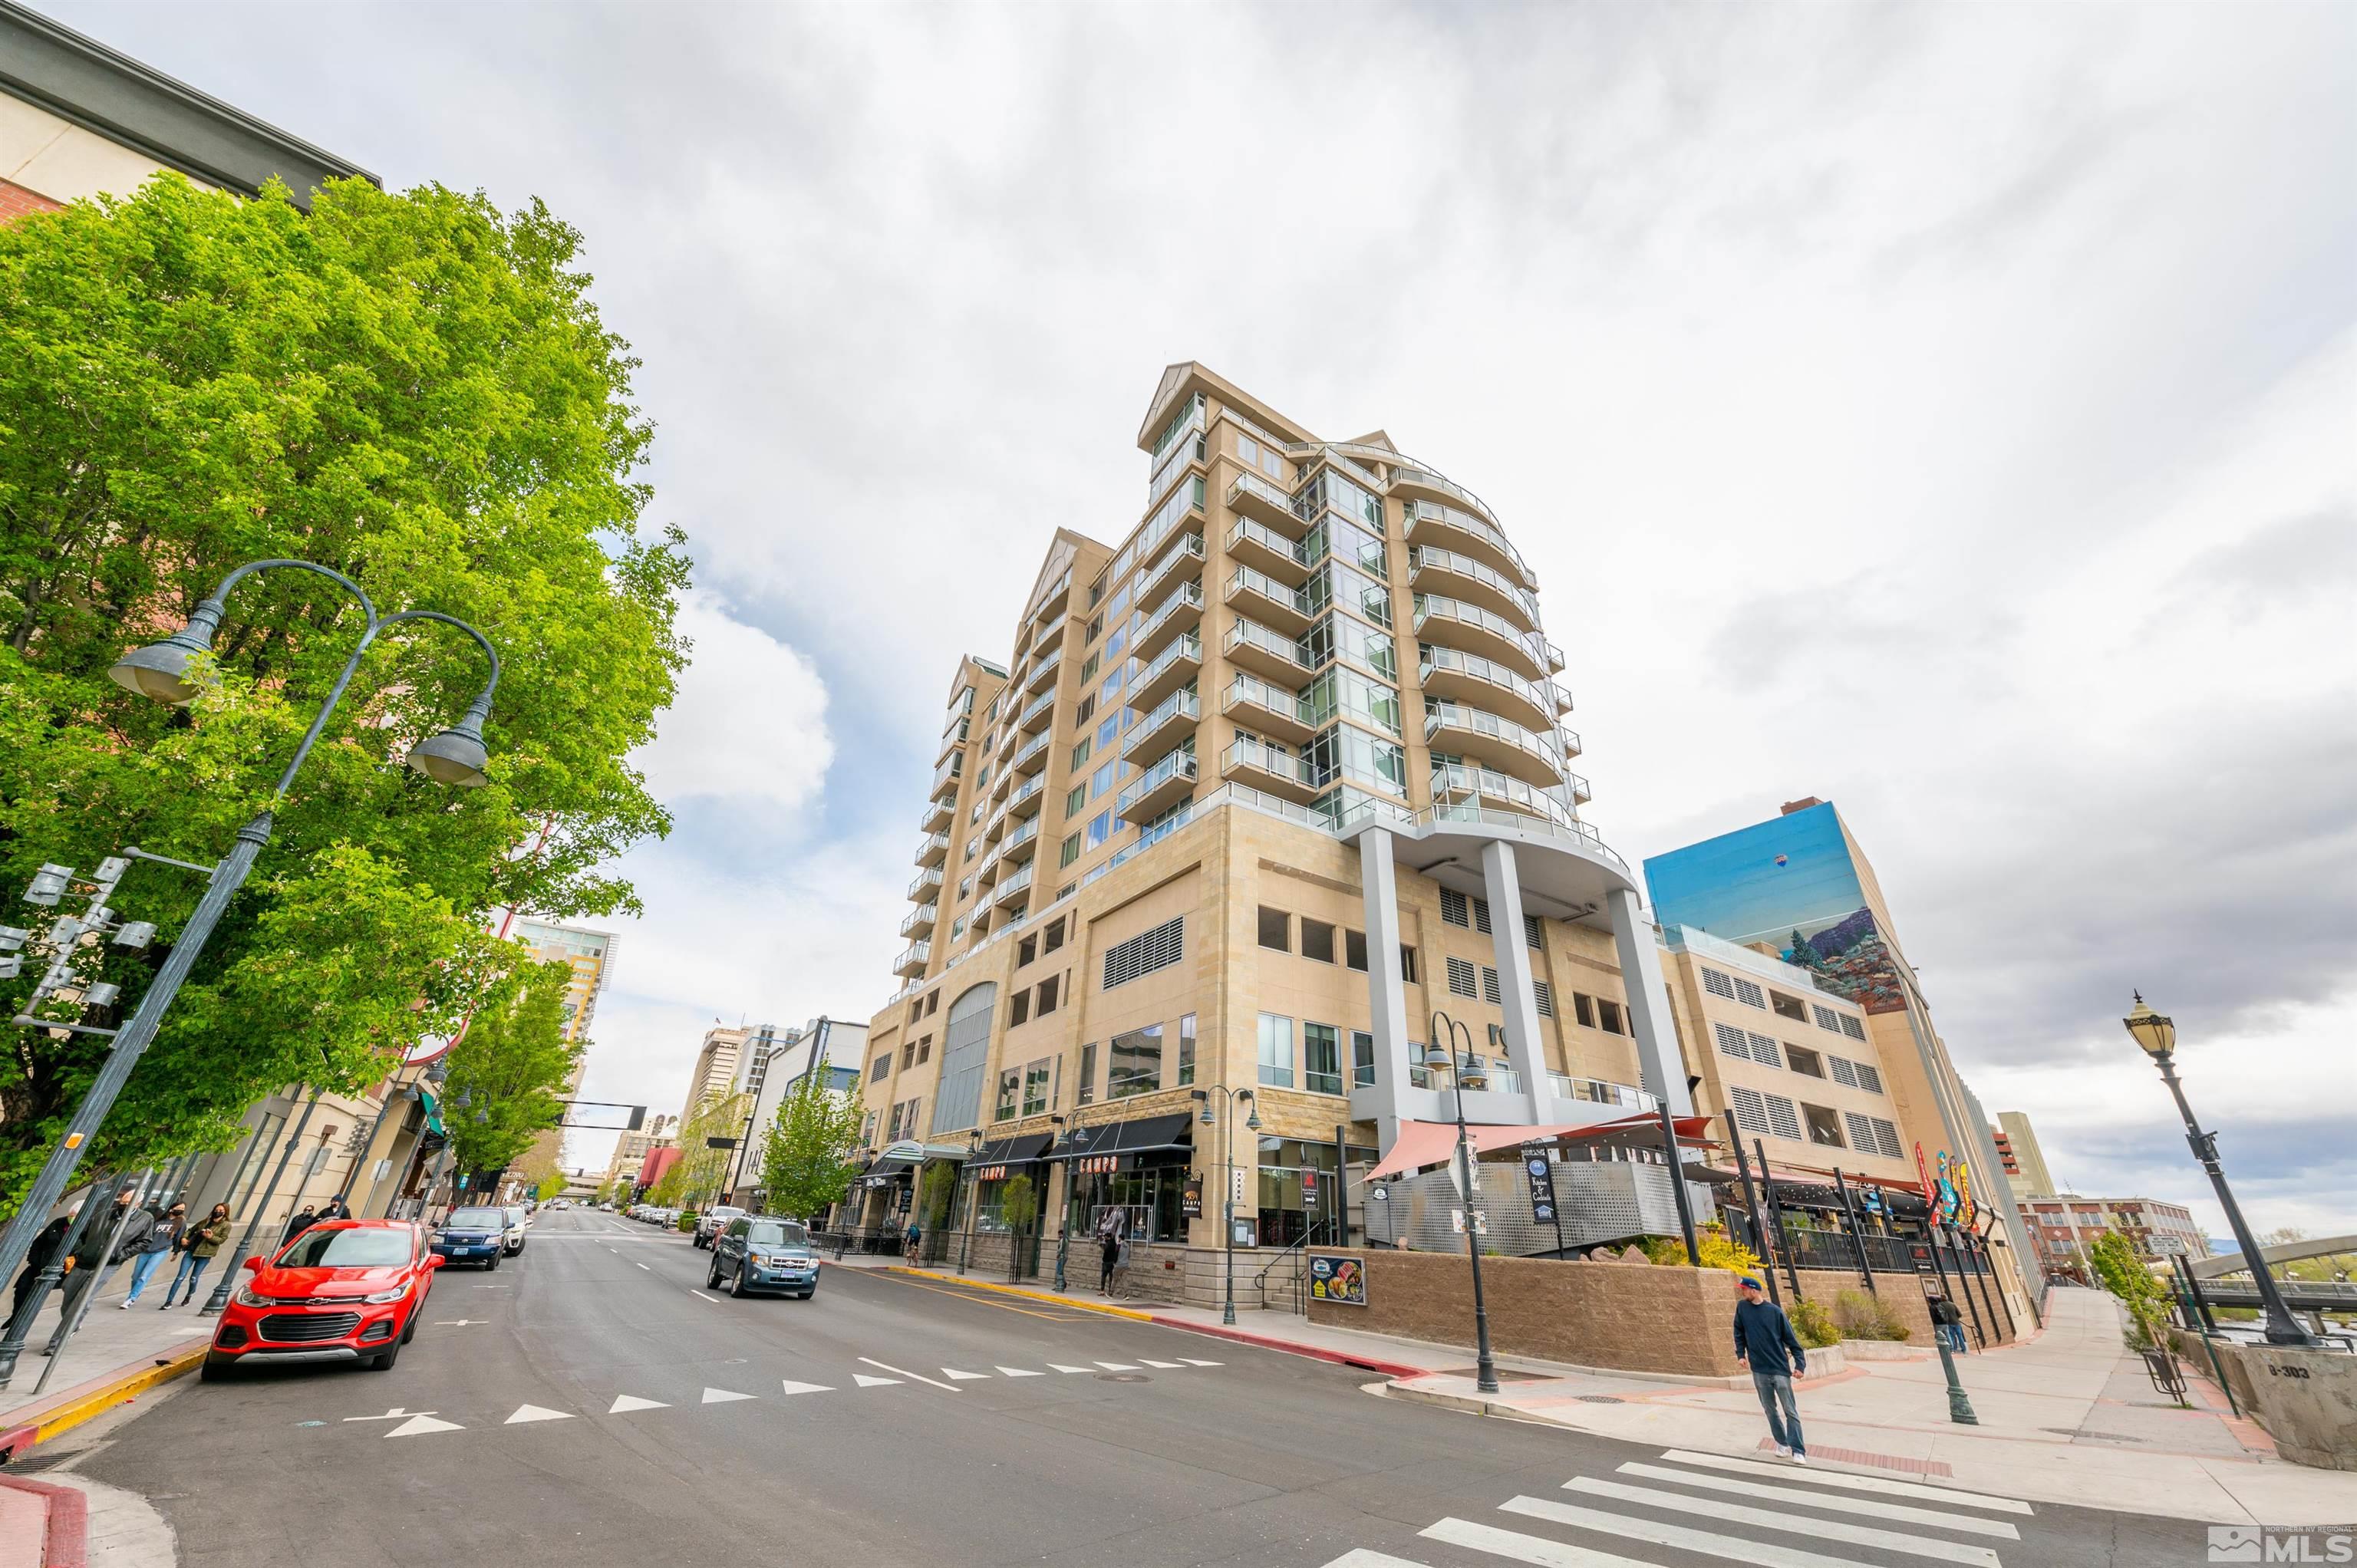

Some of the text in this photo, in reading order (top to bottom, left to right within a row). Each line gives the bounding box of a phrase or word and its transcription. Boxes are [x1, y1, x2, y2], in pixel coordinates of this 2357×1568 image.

[1080, 1155, 1118, 1174] CAMPO
[980, 1165, 1006, 1181] CAMPO
[1531, 1177, 1548, 1186] Kitchen
[1532, 1191, 1551, 1201] Cocktails
